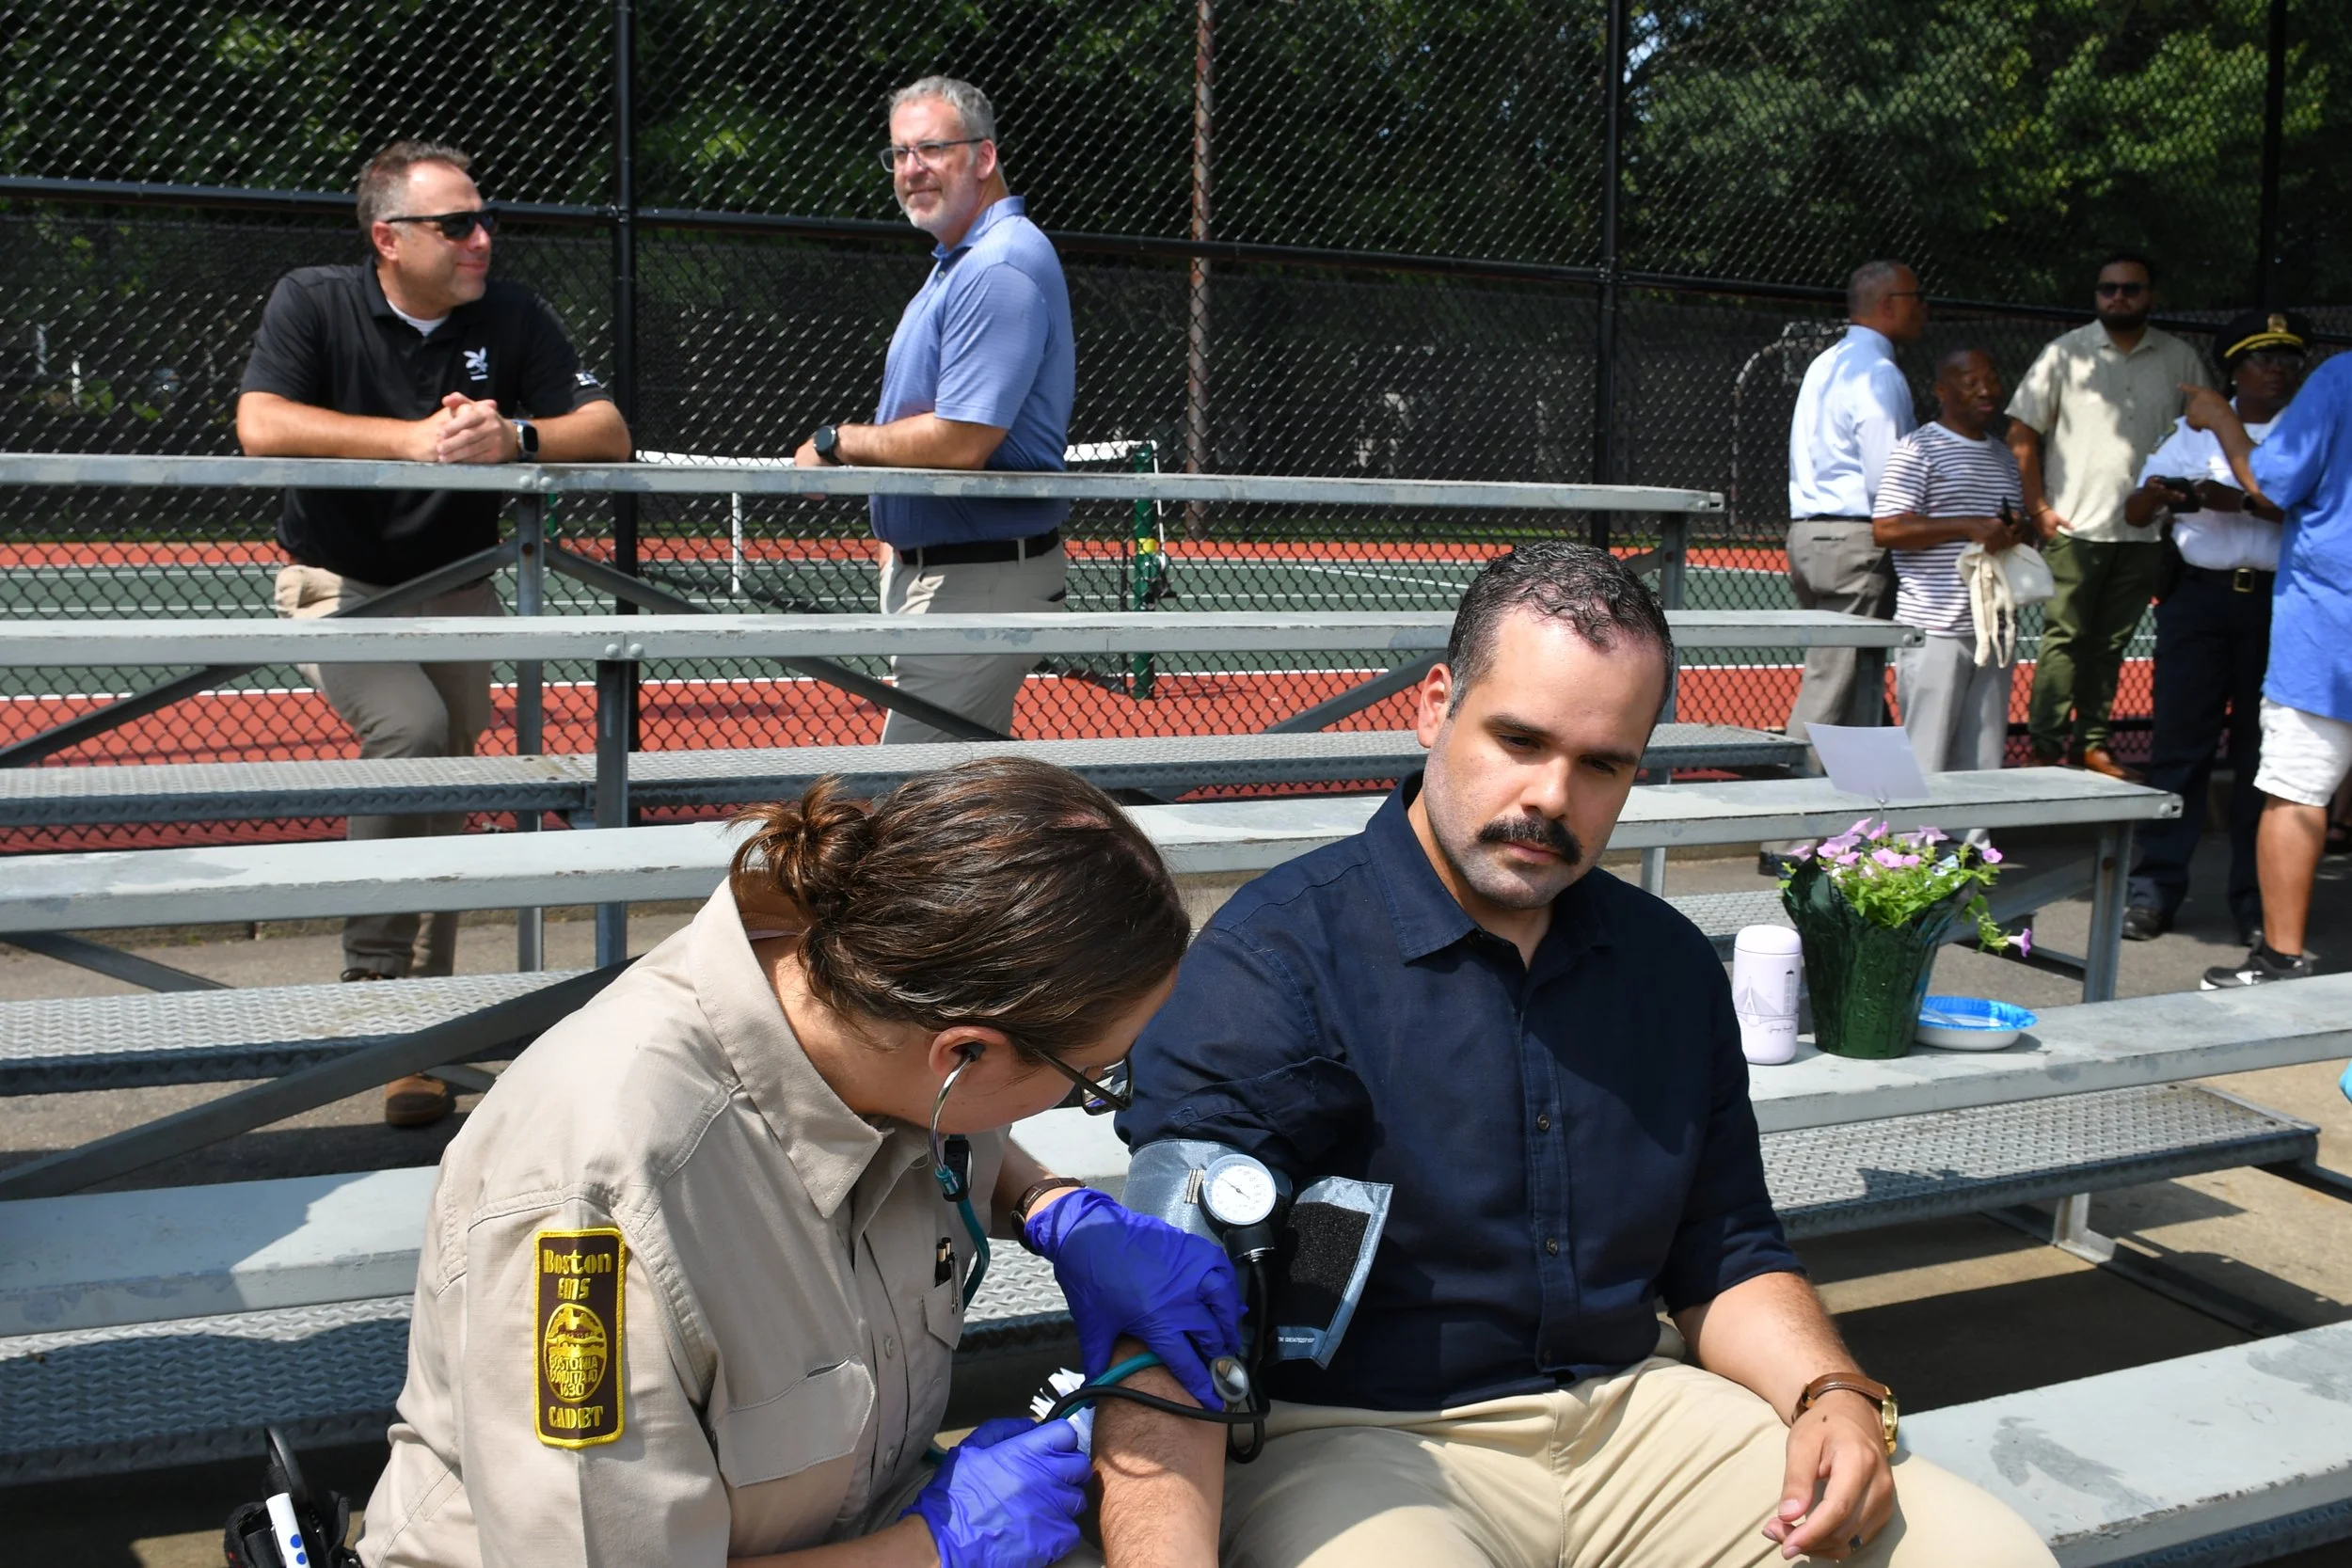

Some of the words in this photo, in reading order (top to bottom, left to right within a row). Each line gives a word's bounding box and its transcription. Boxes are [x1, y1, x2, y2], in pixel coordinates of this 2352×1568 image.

[543, 1249, 612, 1274] Boston
[557, 1277, 591, 1300] EMS
[560, 1383, 585, 1397] 1630
[548, 1405, 603, 1429] CADET
